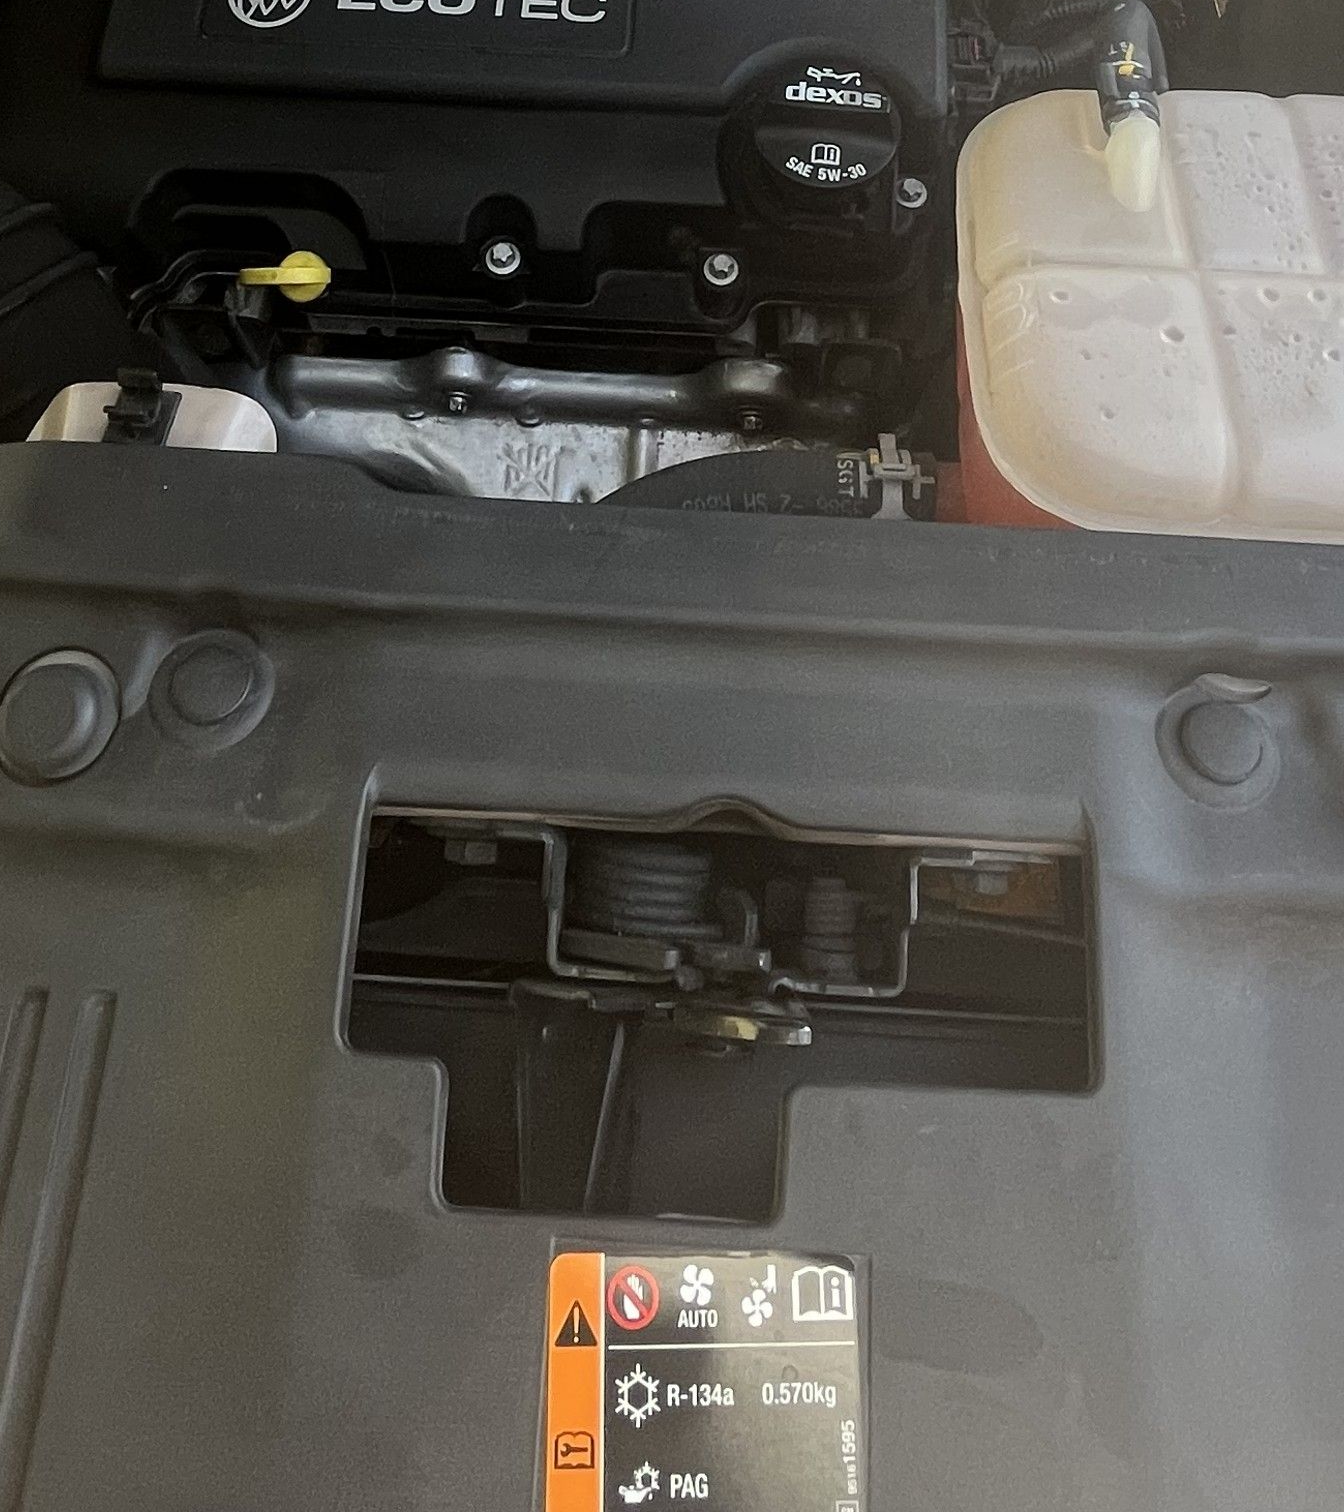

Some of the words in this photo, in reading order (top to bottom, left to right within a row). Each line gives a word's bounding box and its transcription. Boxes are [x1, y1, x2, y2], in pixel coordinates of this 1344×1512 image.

[785, 81, 882, 109] dexos
[785, 156, 814, 178] SAE
[817, 163, 867, 182] 5W-30
[677, 1309, 718, 1329] AUTO
[666, 1384, 735, 1407] R-134a
[761, 1381, 837, 1408] 0.570kg
[669, 1473, 710, 1499] PAG
